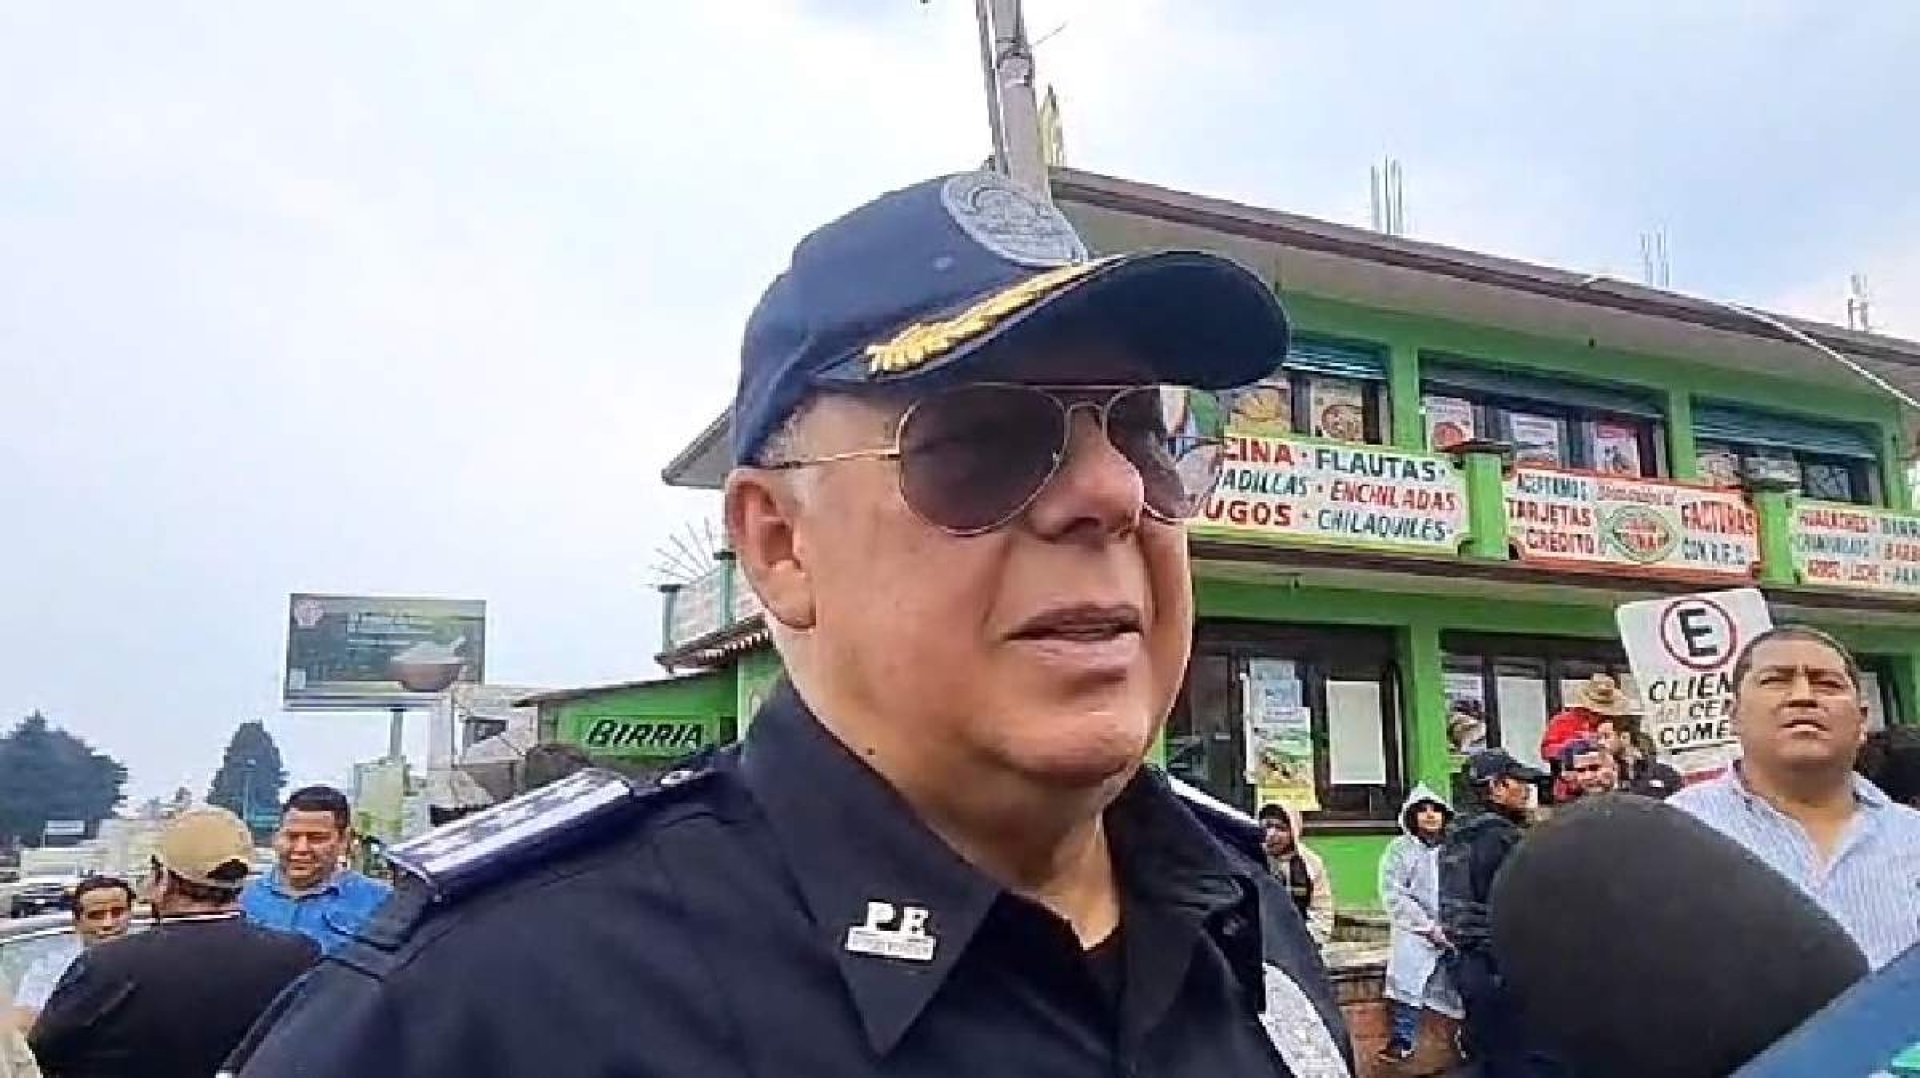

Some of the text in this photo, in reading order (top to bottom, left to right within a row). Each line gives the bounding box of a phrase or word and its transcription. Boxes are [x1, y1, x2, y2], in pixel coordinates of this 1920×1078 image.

[1223, 437, 1436, 482] CINA FLAUTAS
[1215, 468, 1307, 495] ADILLAS
[1205, 499, 1446, 541] UGOS CHILAQUILES
[1508, 499, 1591, 527] TARJETAS
[1677, 608, 1718, 657] E
[1649, 672, 1734, 704] CLIEN
[586, 719, 704, 748] BIRRIA
[1660, 720, 1730, 746] COME
